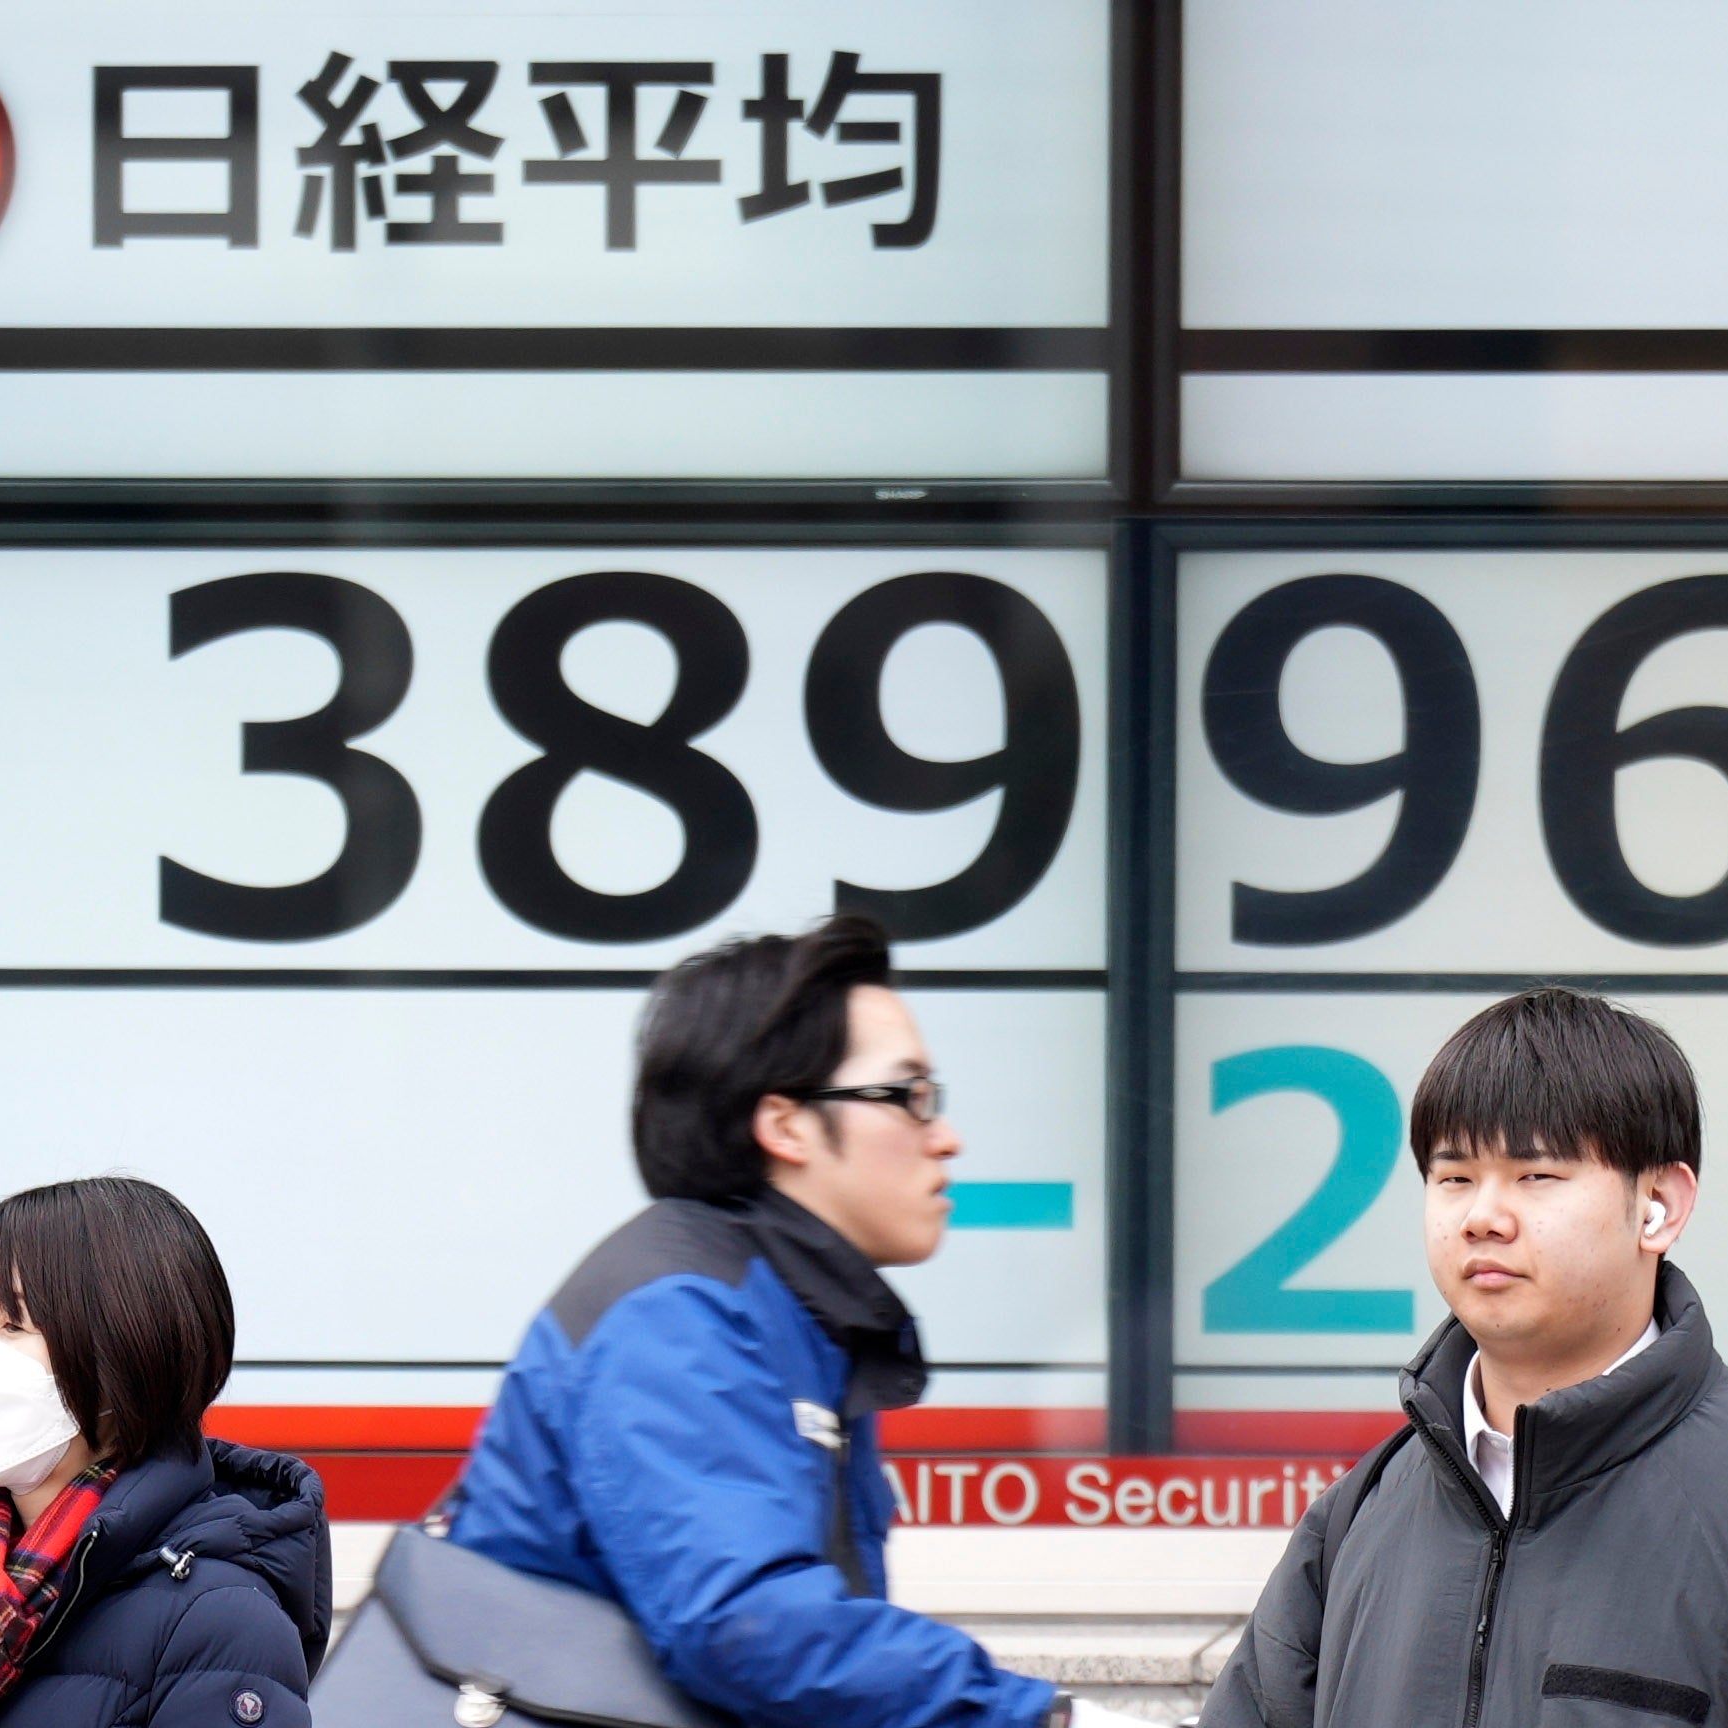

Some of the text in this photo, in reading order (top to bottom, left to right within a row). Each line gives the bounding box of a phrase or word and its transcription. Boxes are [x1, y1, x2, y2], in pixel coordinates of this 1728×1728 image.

[92, 50, 944, 254] 日経平均
[1065, 1462, 1345, 1527] Securit
